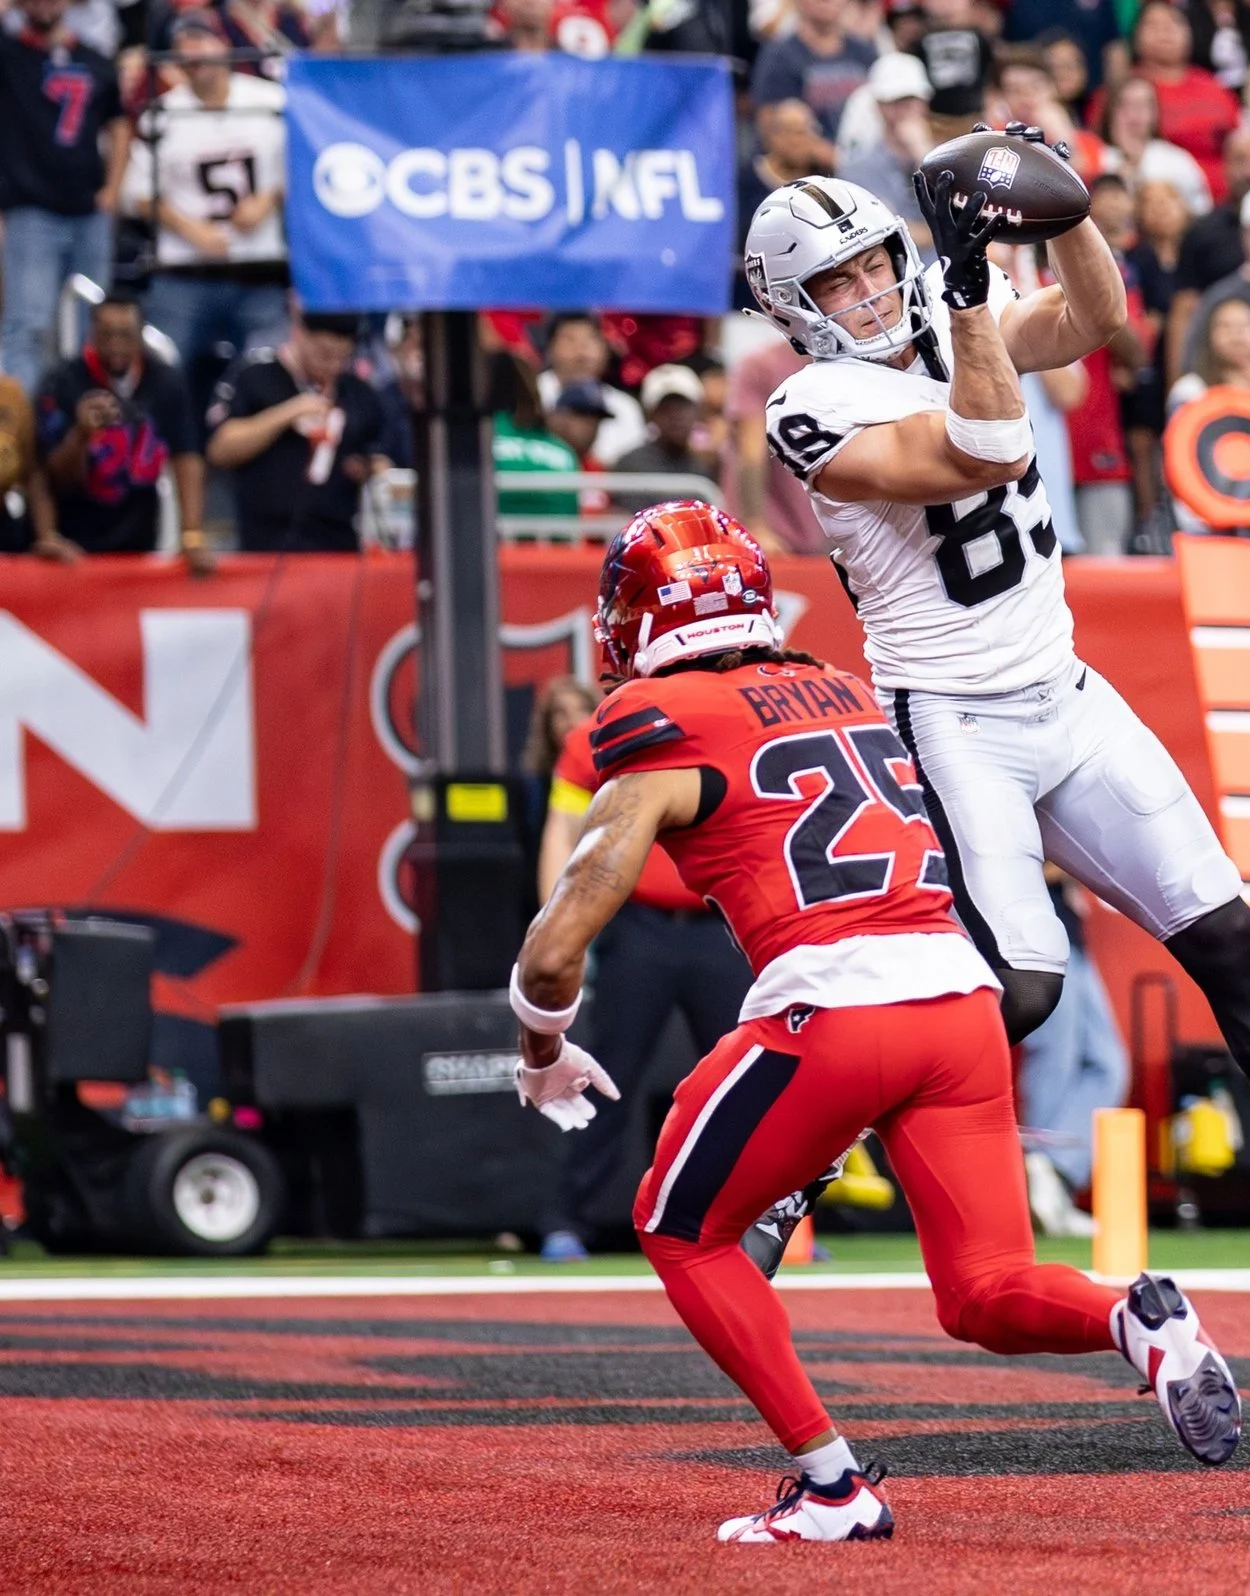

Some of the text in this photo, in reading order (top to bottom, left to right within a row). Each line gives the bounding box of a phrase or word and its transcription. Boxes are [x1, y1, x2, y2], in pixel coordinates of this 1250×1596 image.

[386, 146, 725, 222] CBS NFL
[687, 623, 745, 639] HOUSTON
[0, 606, 259, 831] N
